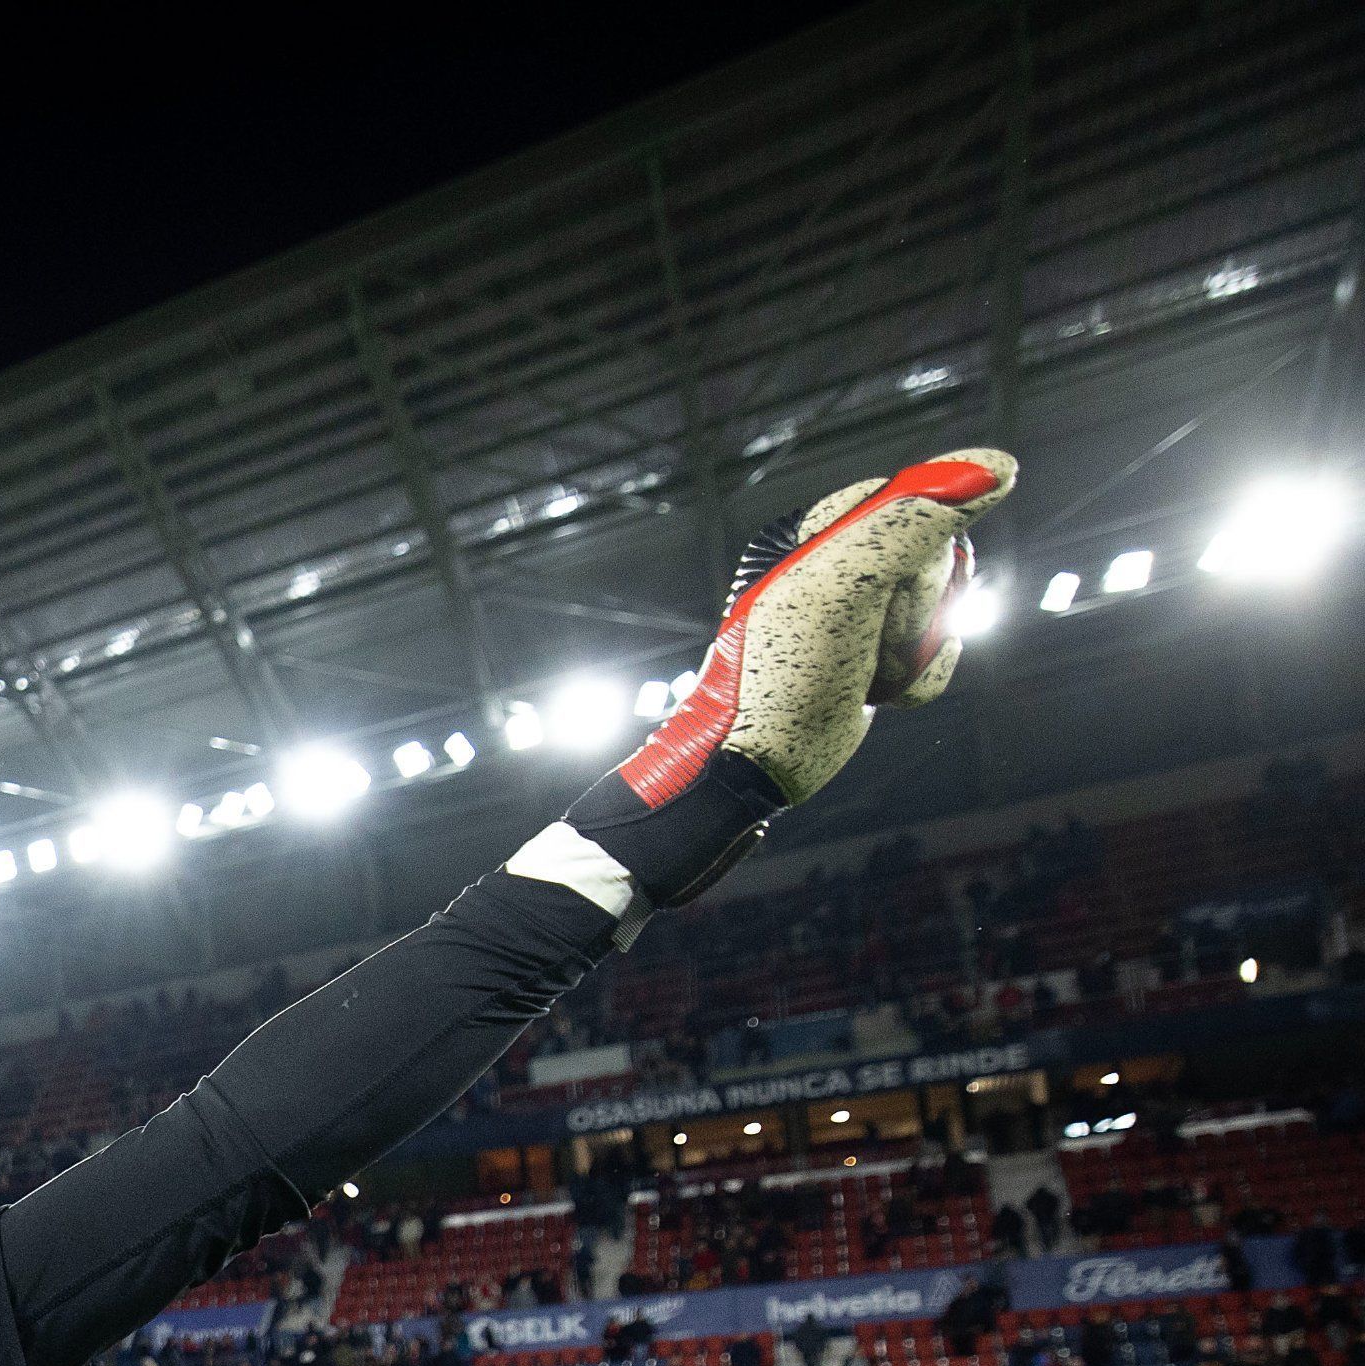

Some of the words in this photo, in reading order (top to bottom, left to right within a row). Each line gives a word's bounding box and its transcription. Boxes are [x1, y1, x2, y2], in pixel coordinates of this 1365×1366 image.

[568, 1088, 722, 1132] OSASUNA
[727, 1069, 852, 1110] NUNCA
[857, 1061, 904, 1092] SE
[908, 1043, 1028, 1084] RINDE
[768, 1286, 921, 1323] helvetia
